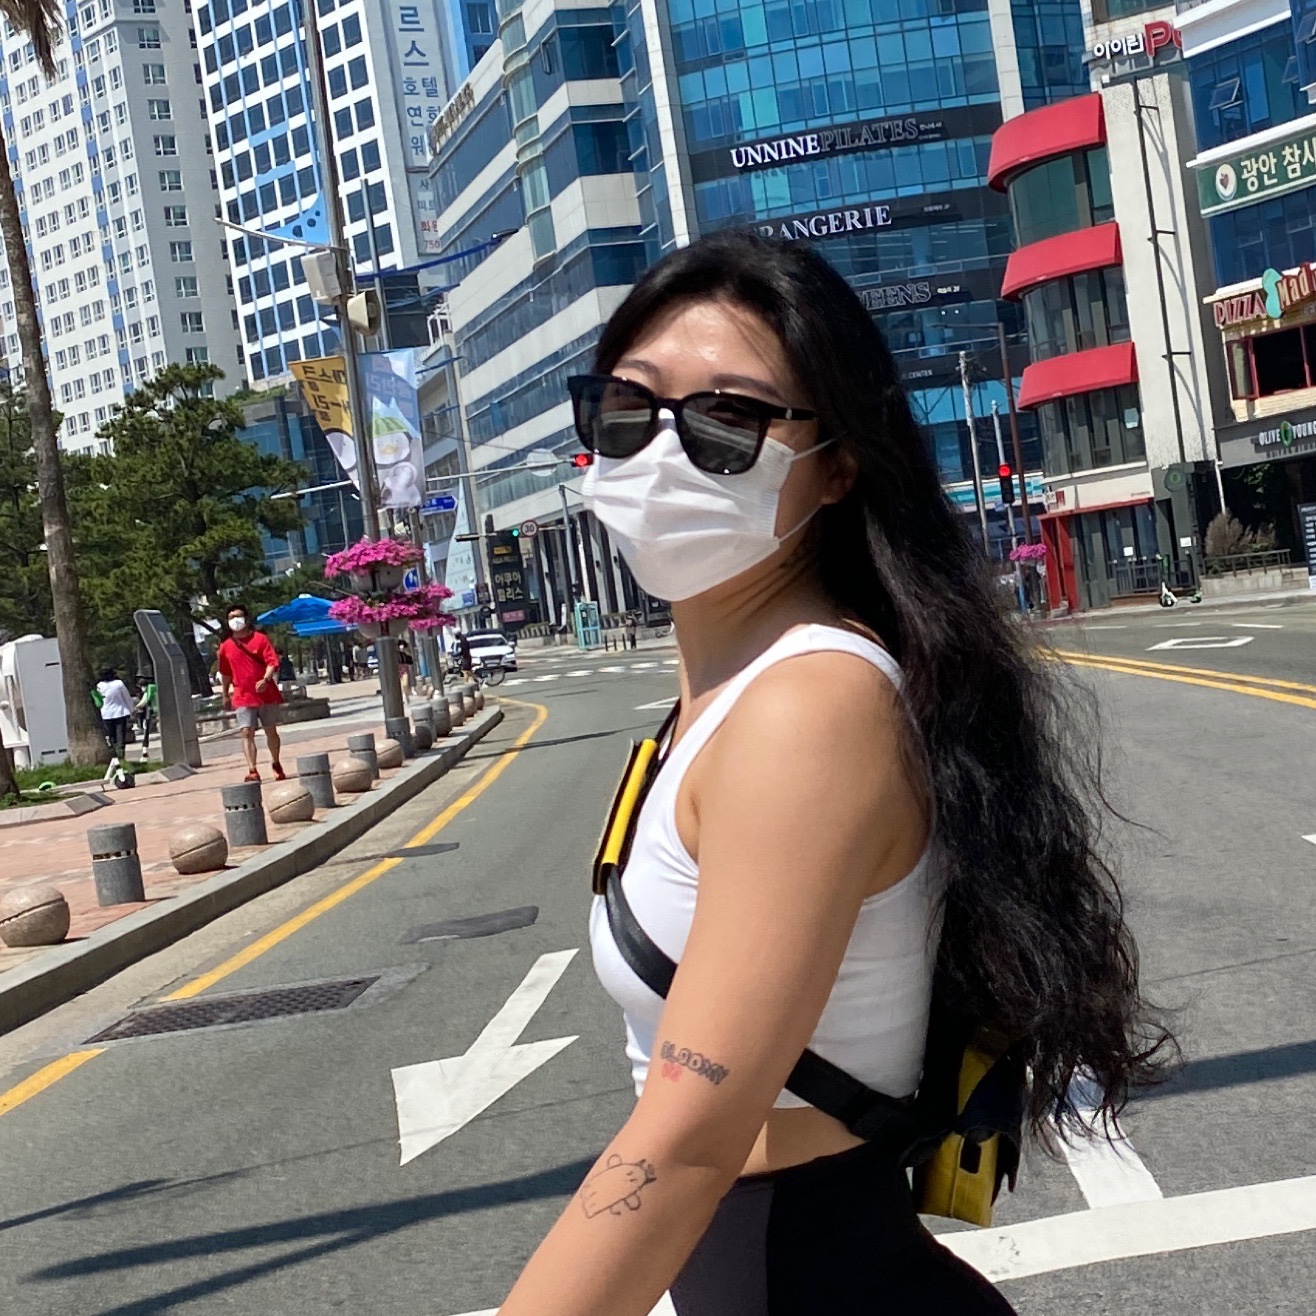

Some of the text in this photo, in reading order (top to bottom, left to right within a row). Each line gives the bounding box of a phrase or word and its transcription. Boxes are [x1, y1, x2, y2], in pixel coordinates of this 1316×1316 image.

[1093, 33, 1145, 60] 아이린
[403, 76, 440, 98] 호텔
[1240, 151, 1278, 193] 광안
[858, 281, 932, 310] EENS
[1213, 293, 1267, 327] PIZZA
[1277, 263, 1311, 310] Mad
[1258, 428, 1281, 446] OLIVE
